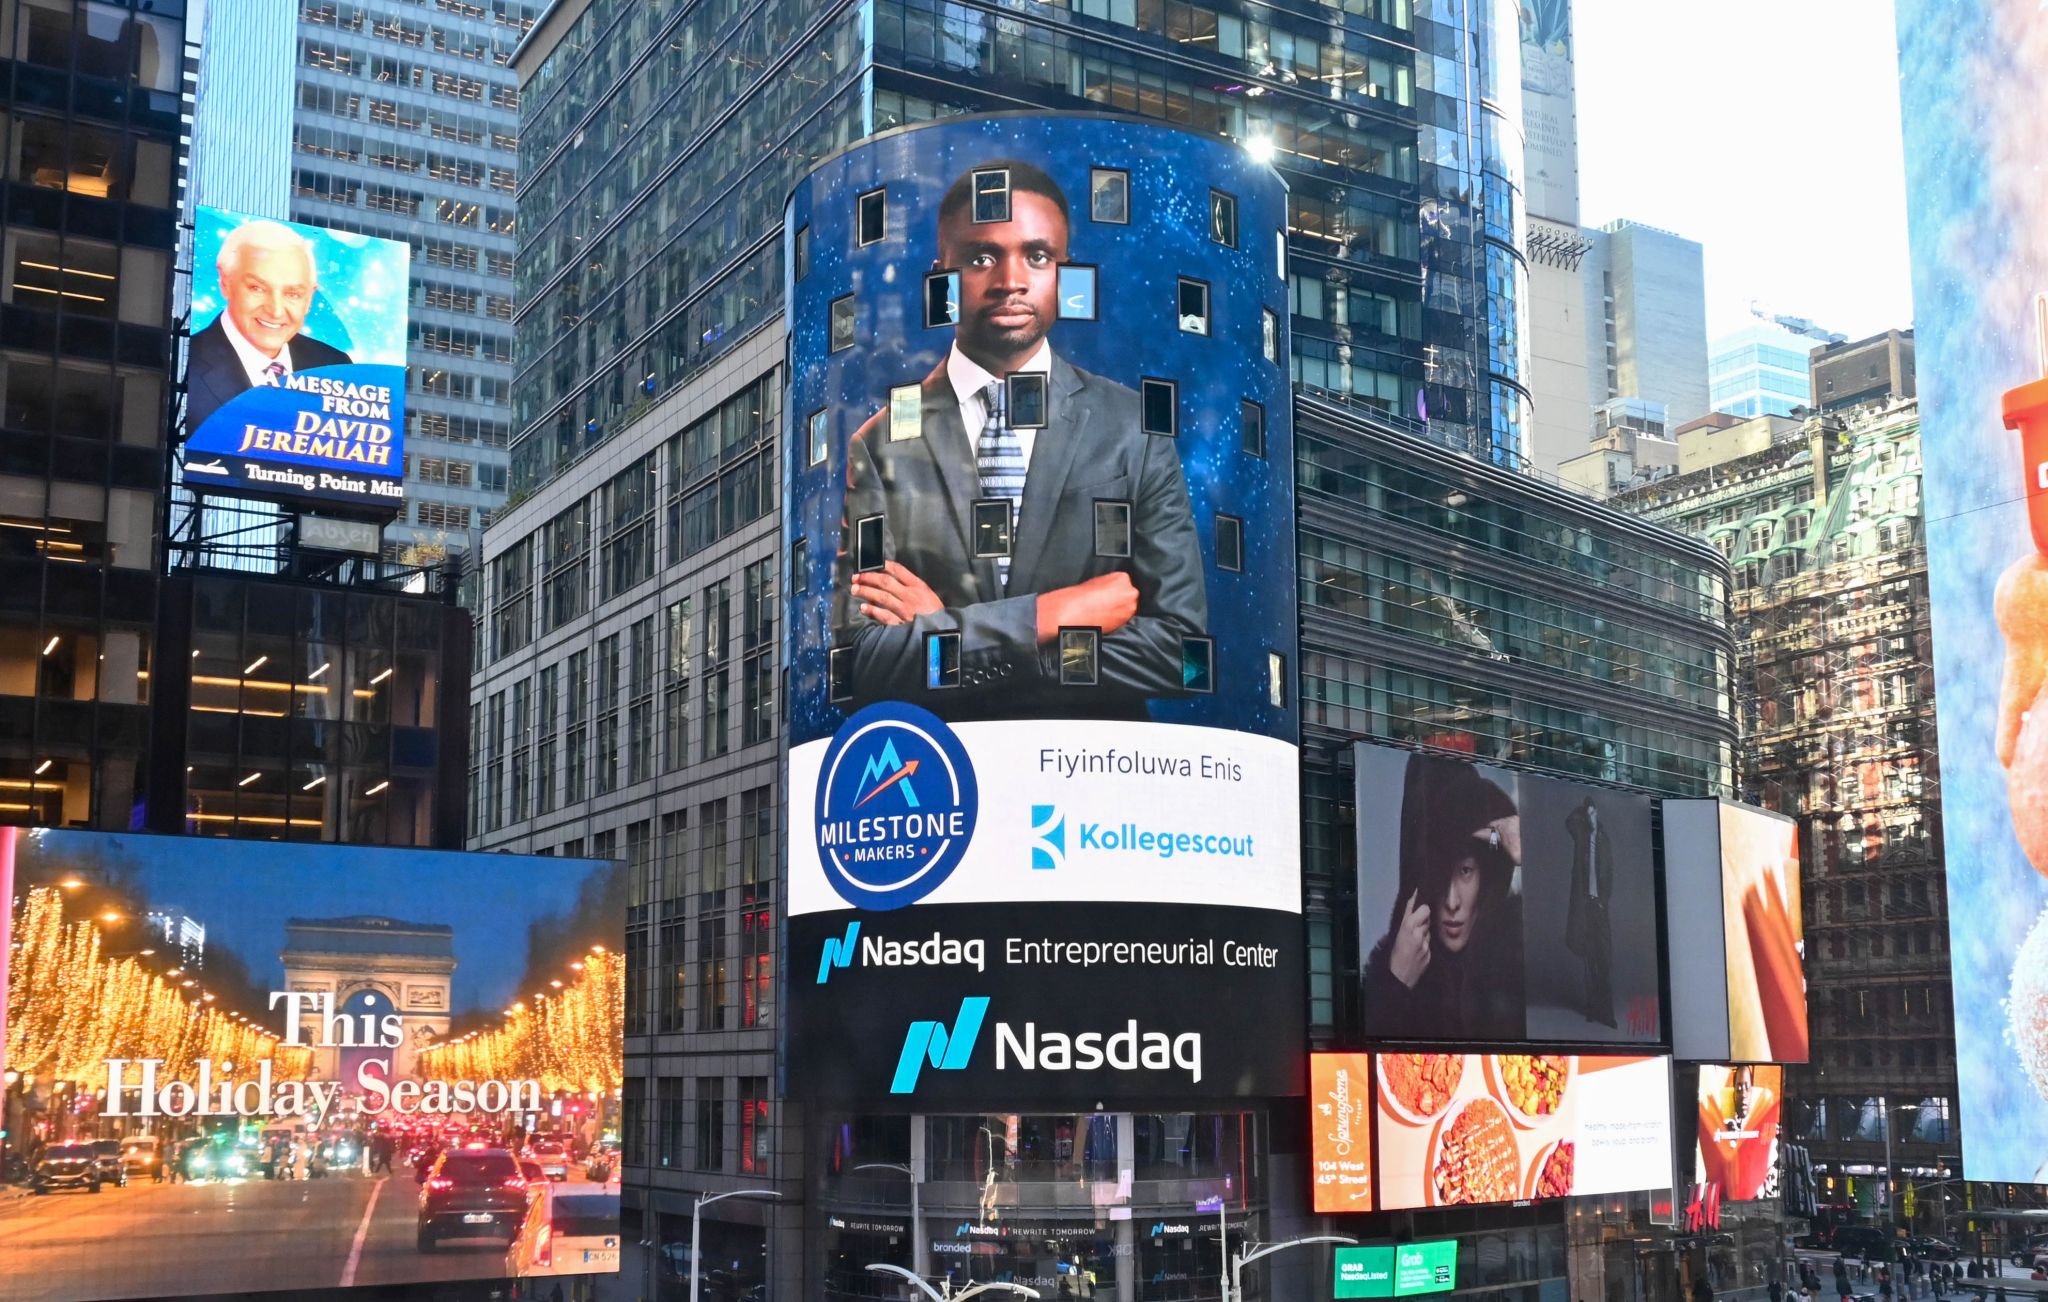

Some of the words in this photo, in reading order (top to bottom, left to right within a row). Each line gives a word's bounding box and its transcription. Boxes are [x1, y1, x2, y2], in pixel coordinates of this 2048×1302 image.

[264, 368, 280, 388] A
[284, 374, 391, 403] MESSAGE
[321, 395, 391, 421] FROM
[293, 410, 392, 444] DAVID
[238, 424, 392, 466] JEREMIAH
[244, 463, 315, 491] Turning
[319, 473, 367, 494] Point
[369, 479, 404, 498] Min
[1040, 748, 1192, 779] Fiyinfoluwa
[1201, 754, 1243, 782] Enis
[821, 812, 964, 847] MILESTONE
[1080, 823, 1254, 858] Kollegescout
[854, 844, 915, 863] MAKERS
[862, 932, 985, 973] Nasdaq
[1006, 937, 1214, 968] Entrepreneurial
[1223, 940, 1279, 968] Center
[269, 990, 404, 1049] This
[995, 1018, 1202, 1084] Nasdaq
[98, 1058, 342, 1132] Holiday
[356, 1058, 543, 1114] Season
[1328, 1068, 1355, 1156] Springbone
[1338, 1161, 1364, 1172] West
[1339, 1174, 1368, 1185] Street
[1012, 1227, 1048, 1236] REWRITE
[1051, 1227, 1096, 1236] TOMORROW
[1163, 1224, 1190, 1235] Nasdaq
[933, 1242, 972, 1254] branded
[1401, 1251, 1424, 1268] Grab
[1013, 1275, 1055, 1289] Nasdaq
